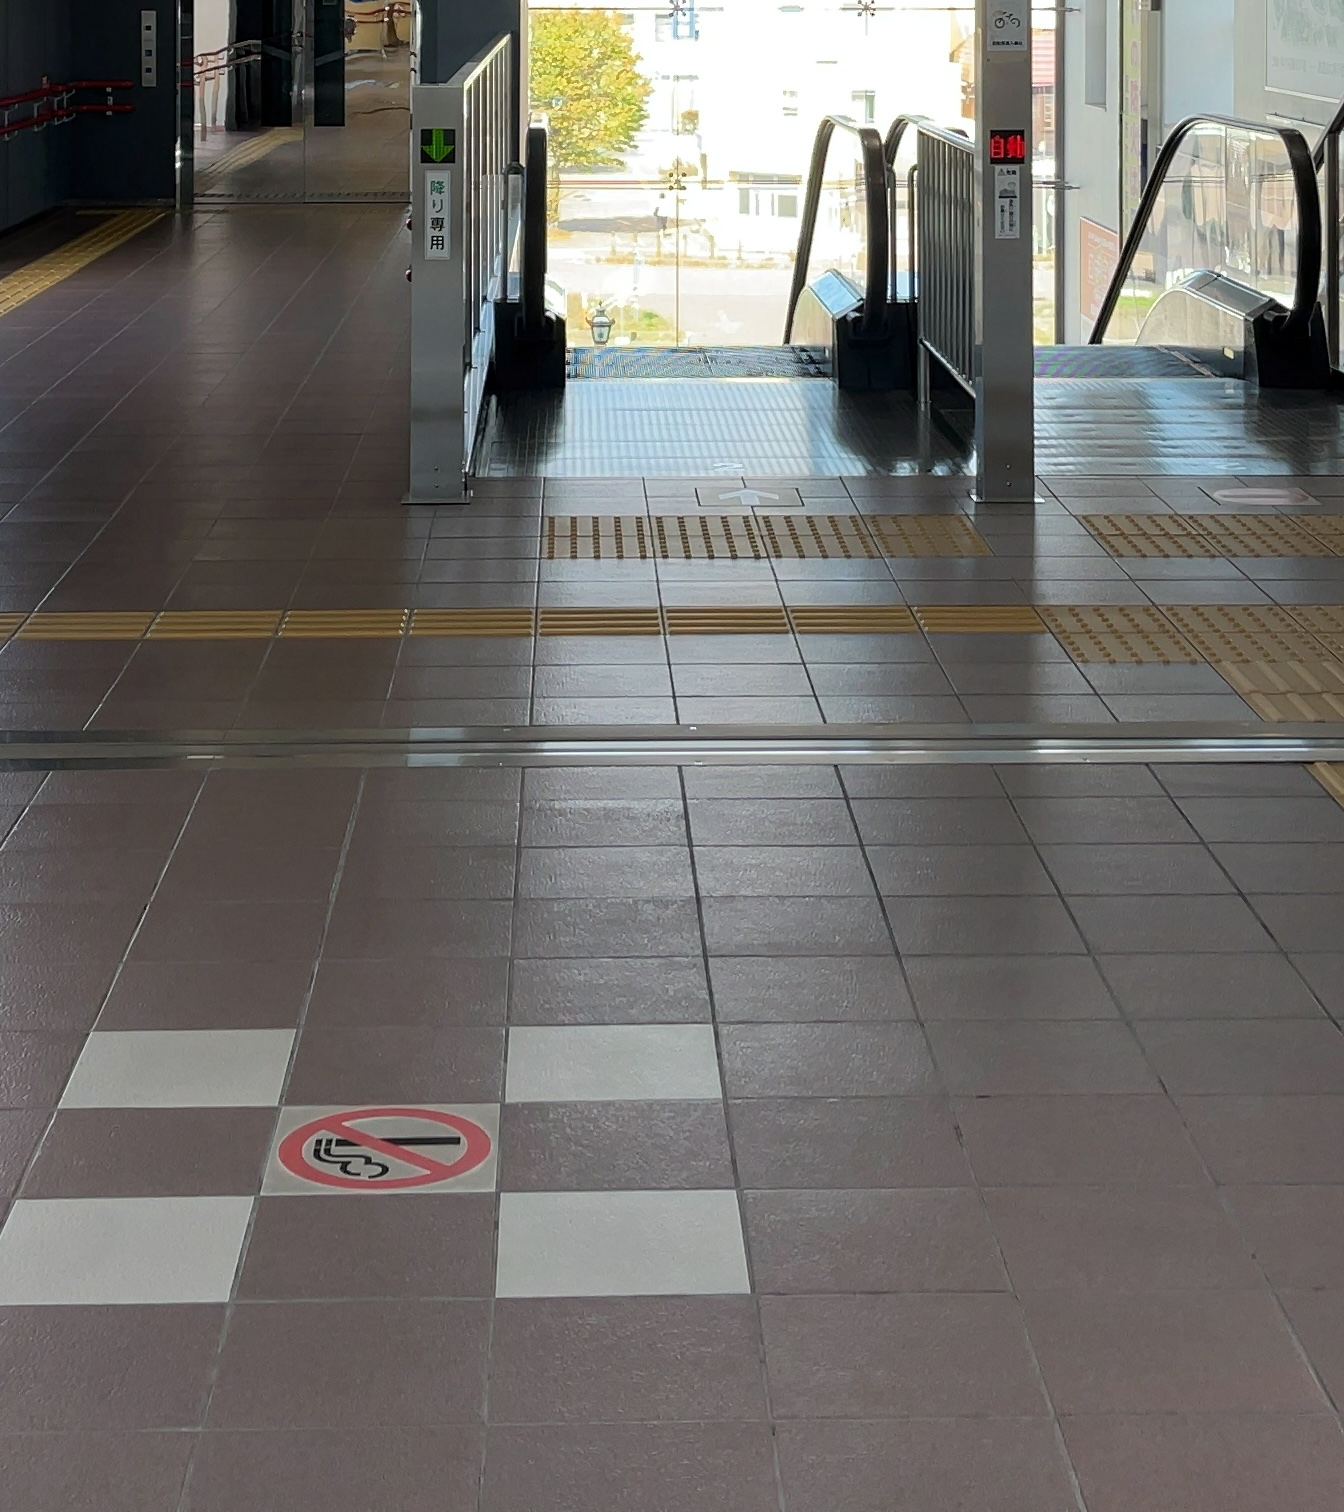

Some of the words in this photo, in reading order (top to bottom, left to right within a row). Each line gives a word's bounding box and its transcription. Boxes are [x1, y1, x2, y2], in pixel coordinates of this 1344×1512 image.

[990, 135, 1025, 158] 自動
[429, 180, 446, 251] 降り専用
